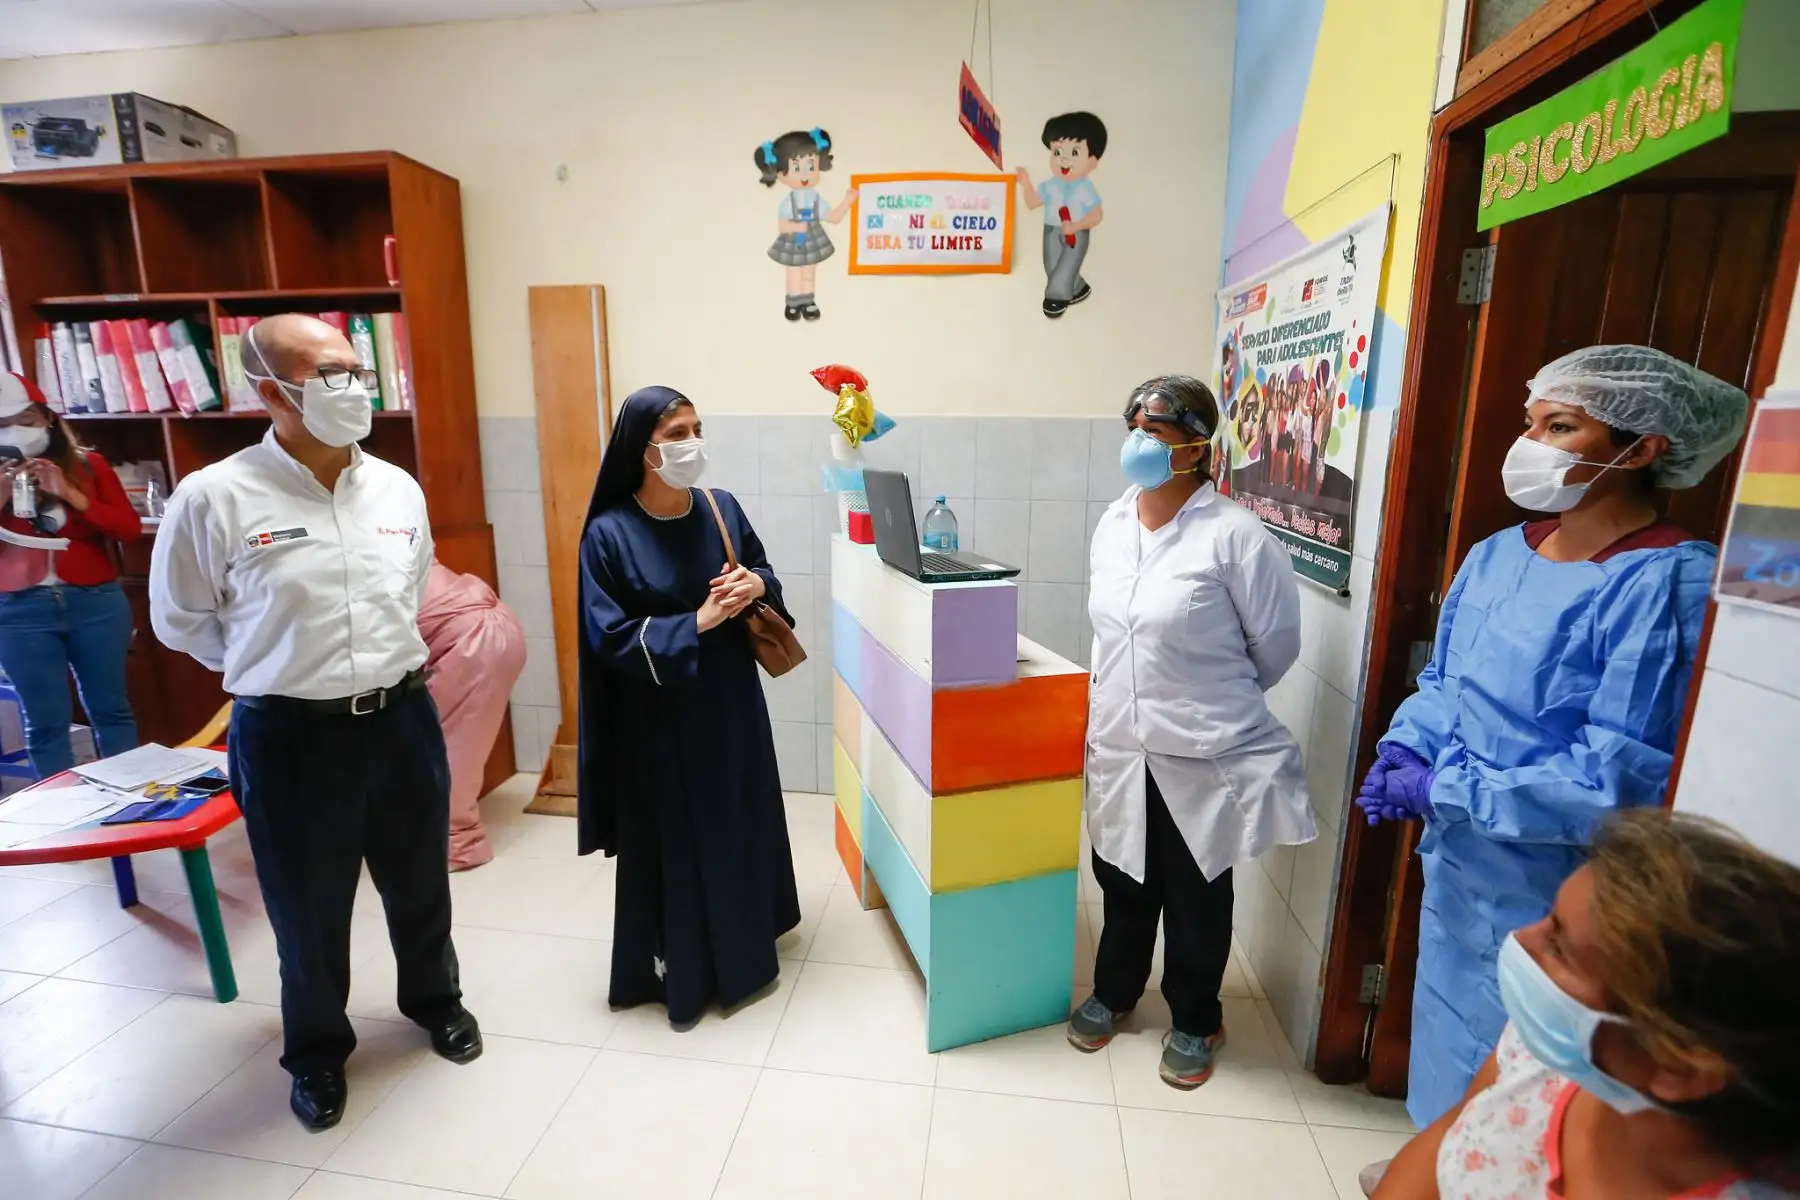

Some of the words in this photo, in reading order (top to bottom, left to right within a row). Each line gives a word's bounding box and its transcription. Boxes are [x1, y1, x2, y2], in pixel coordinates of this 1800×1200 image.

[1481, 41, 1725, 209] PSICOLOGIA
[867, 214, 884, 229] EN
[909, 214, 925, 229] NI
[953, 215, 997, 230] CIELO
[866, 235, 902, 250] SERA
[908, 235, 925, 250] TU
[931, 235, 983, 250] LIMITE
[1242, 330, 1269, 351] SERVICIO
[1272, 310, 1331, 343] DIFERENCIADO
[1314, 555, 1339, 572] cercano
